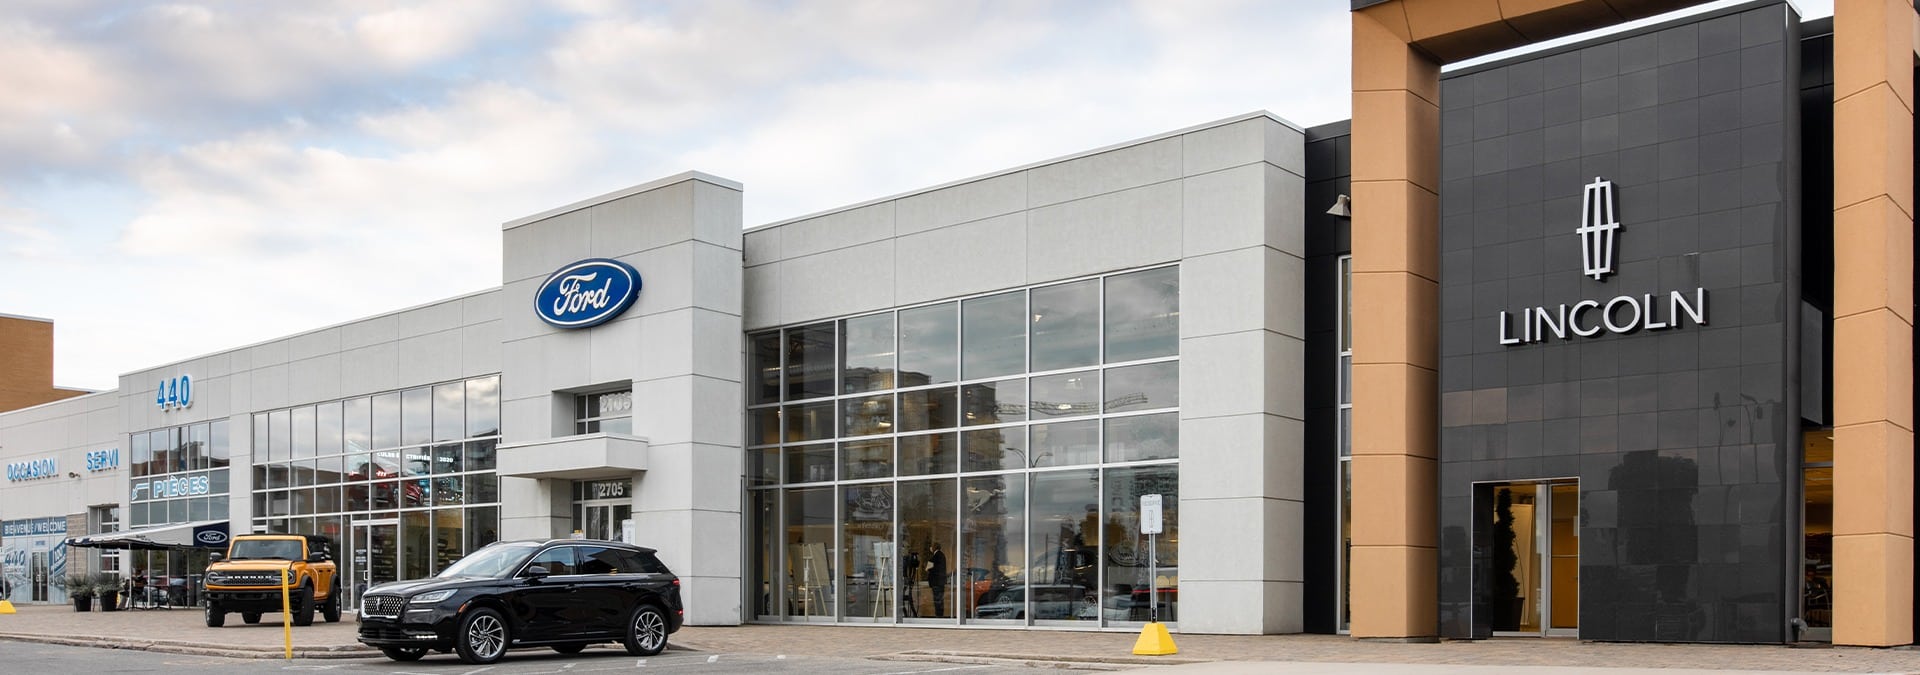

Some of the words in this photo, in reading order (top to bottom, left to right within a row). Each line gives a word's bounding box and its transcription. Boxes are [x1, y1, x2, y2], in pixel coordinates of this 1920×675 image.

[553, 271, 612, 316] Ford
[1500, 287, 1704, 345] LINCOLN
[156, 375, 191, 409] 440
[600, 392, 632, 413] 2705
[7, 458, 55, 480] OCCASION
[86, 448, 119, 470] SERVI
[153, 475, 209, 498] PIÈCES
[600, 481, 624, 497] 2705
[203, 532, 221, 542] Ford
[4, 550, 26, 566] 440
